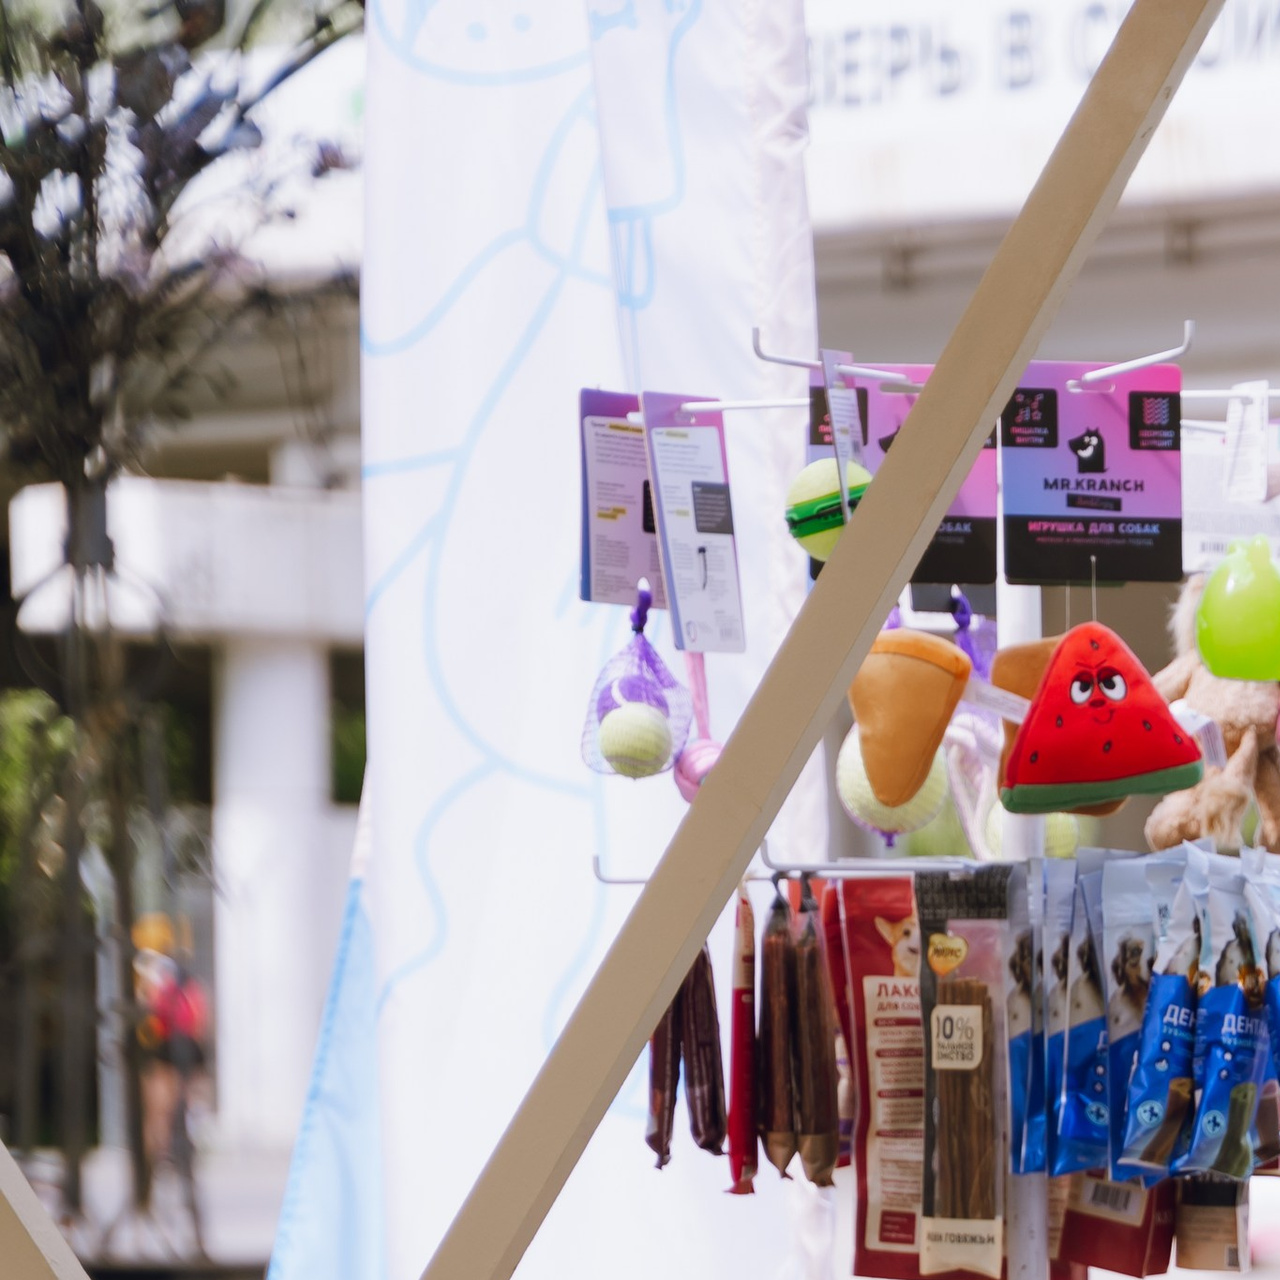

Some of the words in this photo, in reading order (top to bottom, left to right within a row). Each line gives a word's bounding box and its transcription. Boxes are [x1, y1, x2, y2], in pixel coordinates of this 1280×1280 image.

[1043, 477, 1145, 492] MR.KRANCH
[1028, 521, 1085, 533] ИГРУШКА
[1088, 522, 1115, 535] ДЛЯ
[1118, 523, 1160, 535] СОБАК
